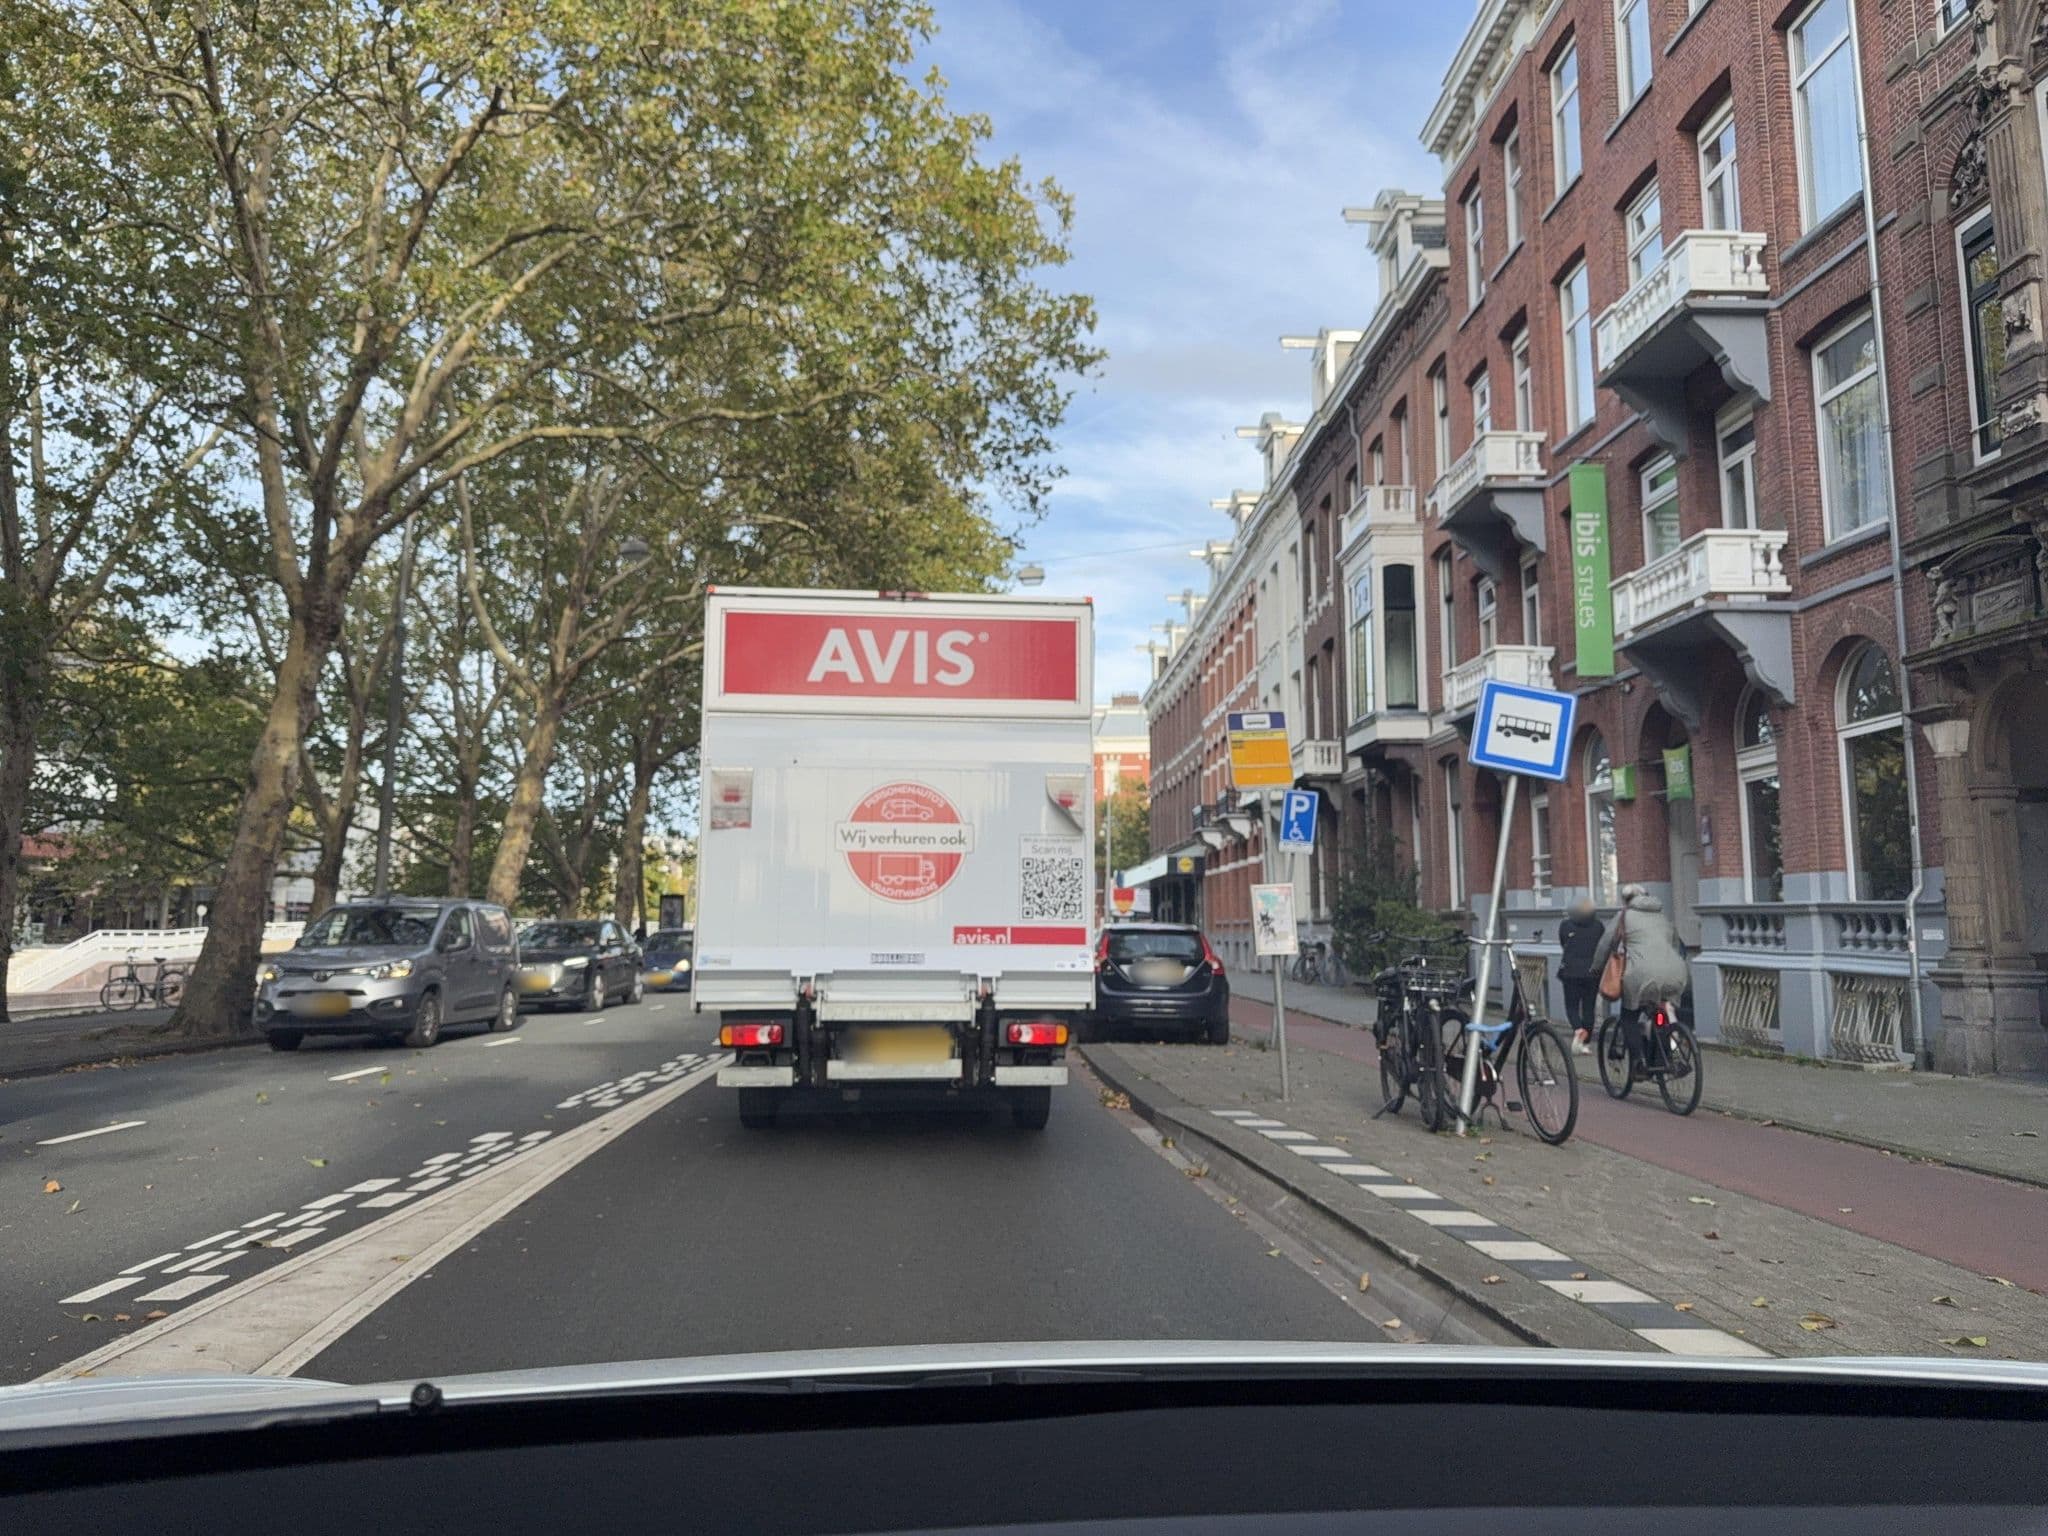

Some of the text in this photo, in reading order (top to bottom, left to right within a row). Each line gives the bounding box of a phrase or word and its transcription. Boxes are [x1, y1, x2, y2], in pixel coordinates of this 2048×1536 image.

[1576, 512, 1601, 557] ibis
[806, 628, 976, 686] AVIS
[1290, 795, 1310, 821] P
[840, 828, 967, 848] Wij verhuren ook
[956, 927, 1012, 945] avis.nl
